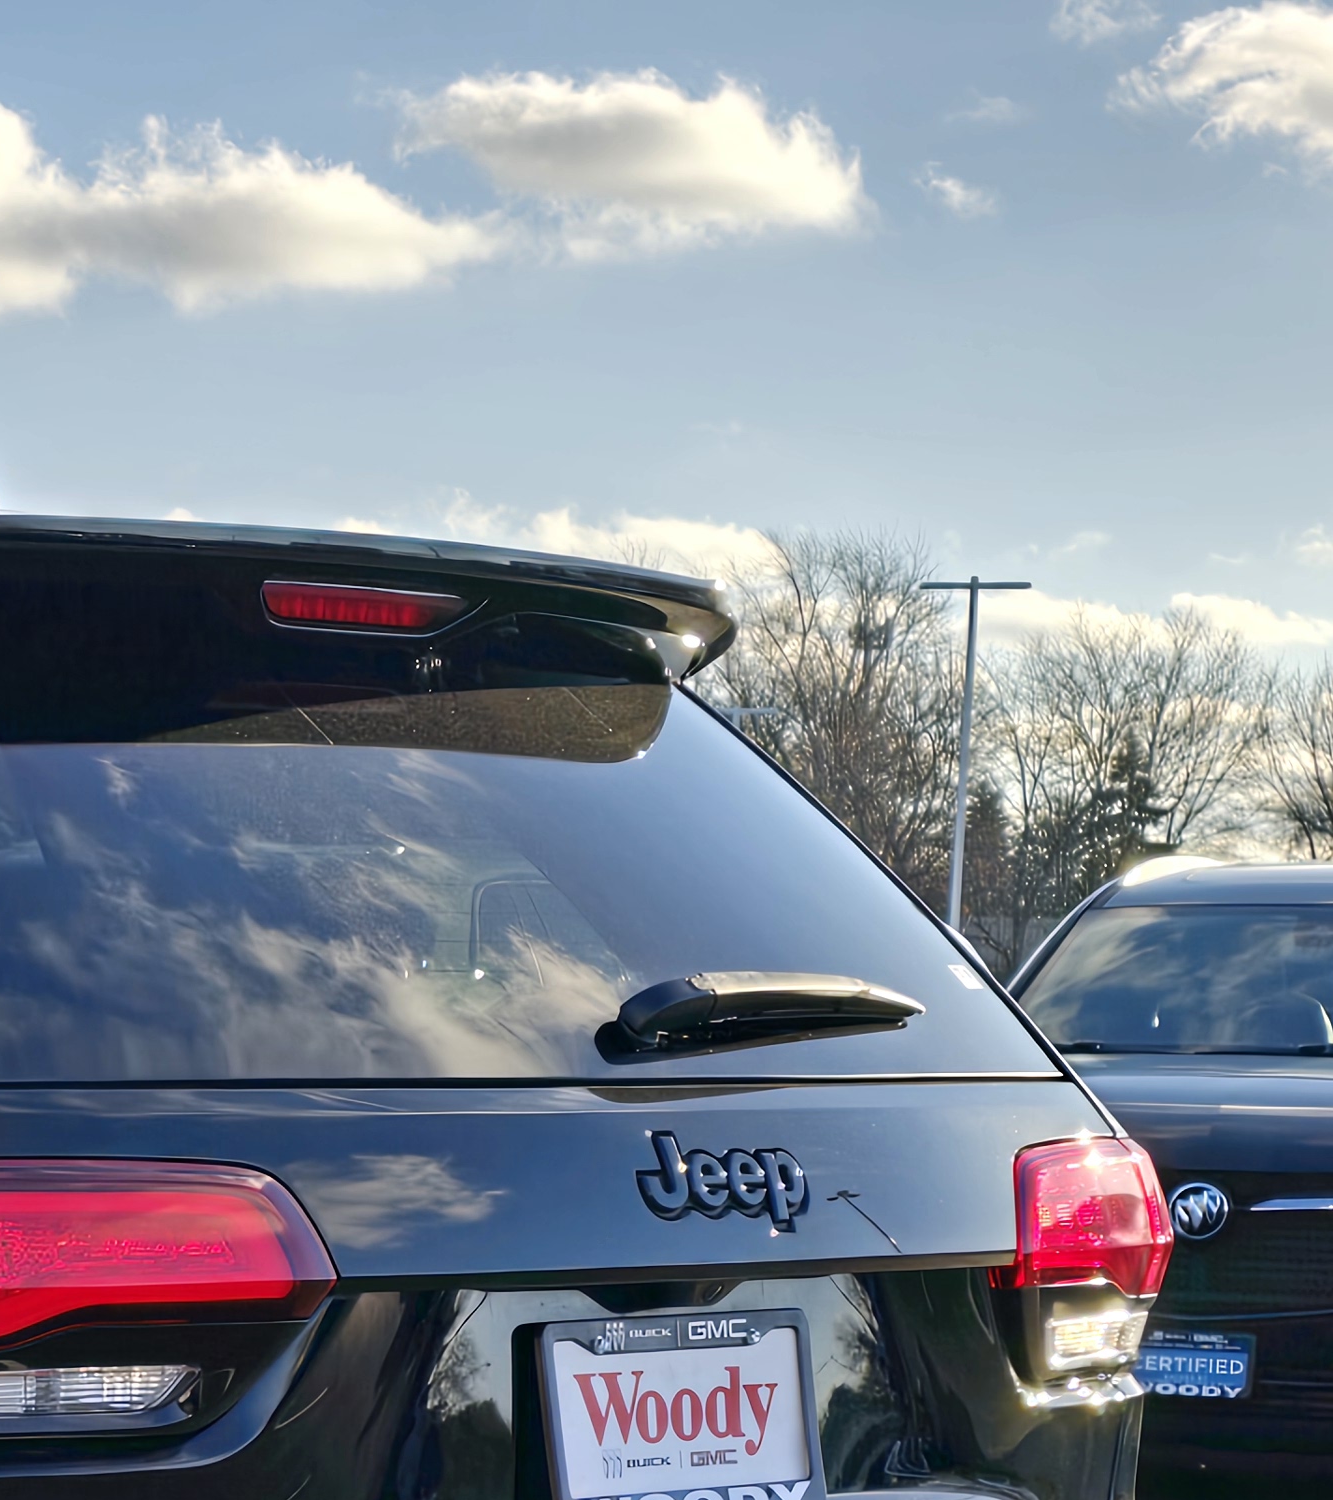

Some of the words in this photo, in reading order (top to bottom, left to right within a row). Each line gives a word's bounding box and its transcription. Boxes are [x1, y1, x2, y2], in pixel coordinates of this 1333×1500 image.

[636, 1130, 810, 1234] Jeep
[688, 1318, 748, 1340] GMC
[573, 1366, 779, 1456] Woody
[626, 1455, 671, 1468] BUICK
[690, 1449, 738, 1467] GMC
